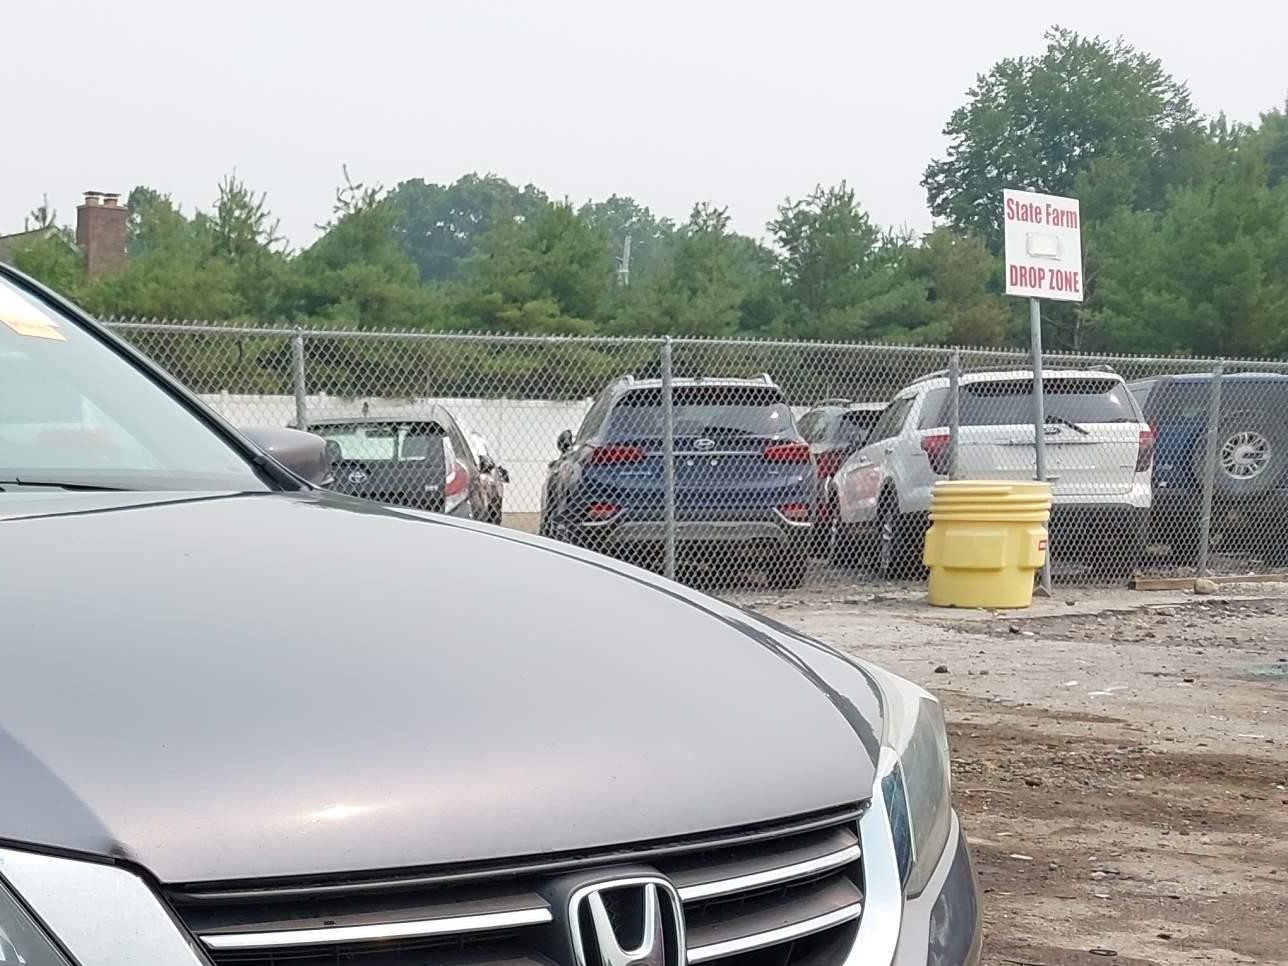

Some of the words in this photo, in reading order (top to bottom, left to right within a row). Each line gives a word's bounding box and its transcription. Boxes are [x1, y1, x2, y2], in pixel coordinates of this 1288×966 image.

[1006, 198, 1042, 225] State
[1046, 203, 1078, 229] Farm
[1009, 264, 1046, 289] DROP
[1048, 268, 1080, 293] ZONE
